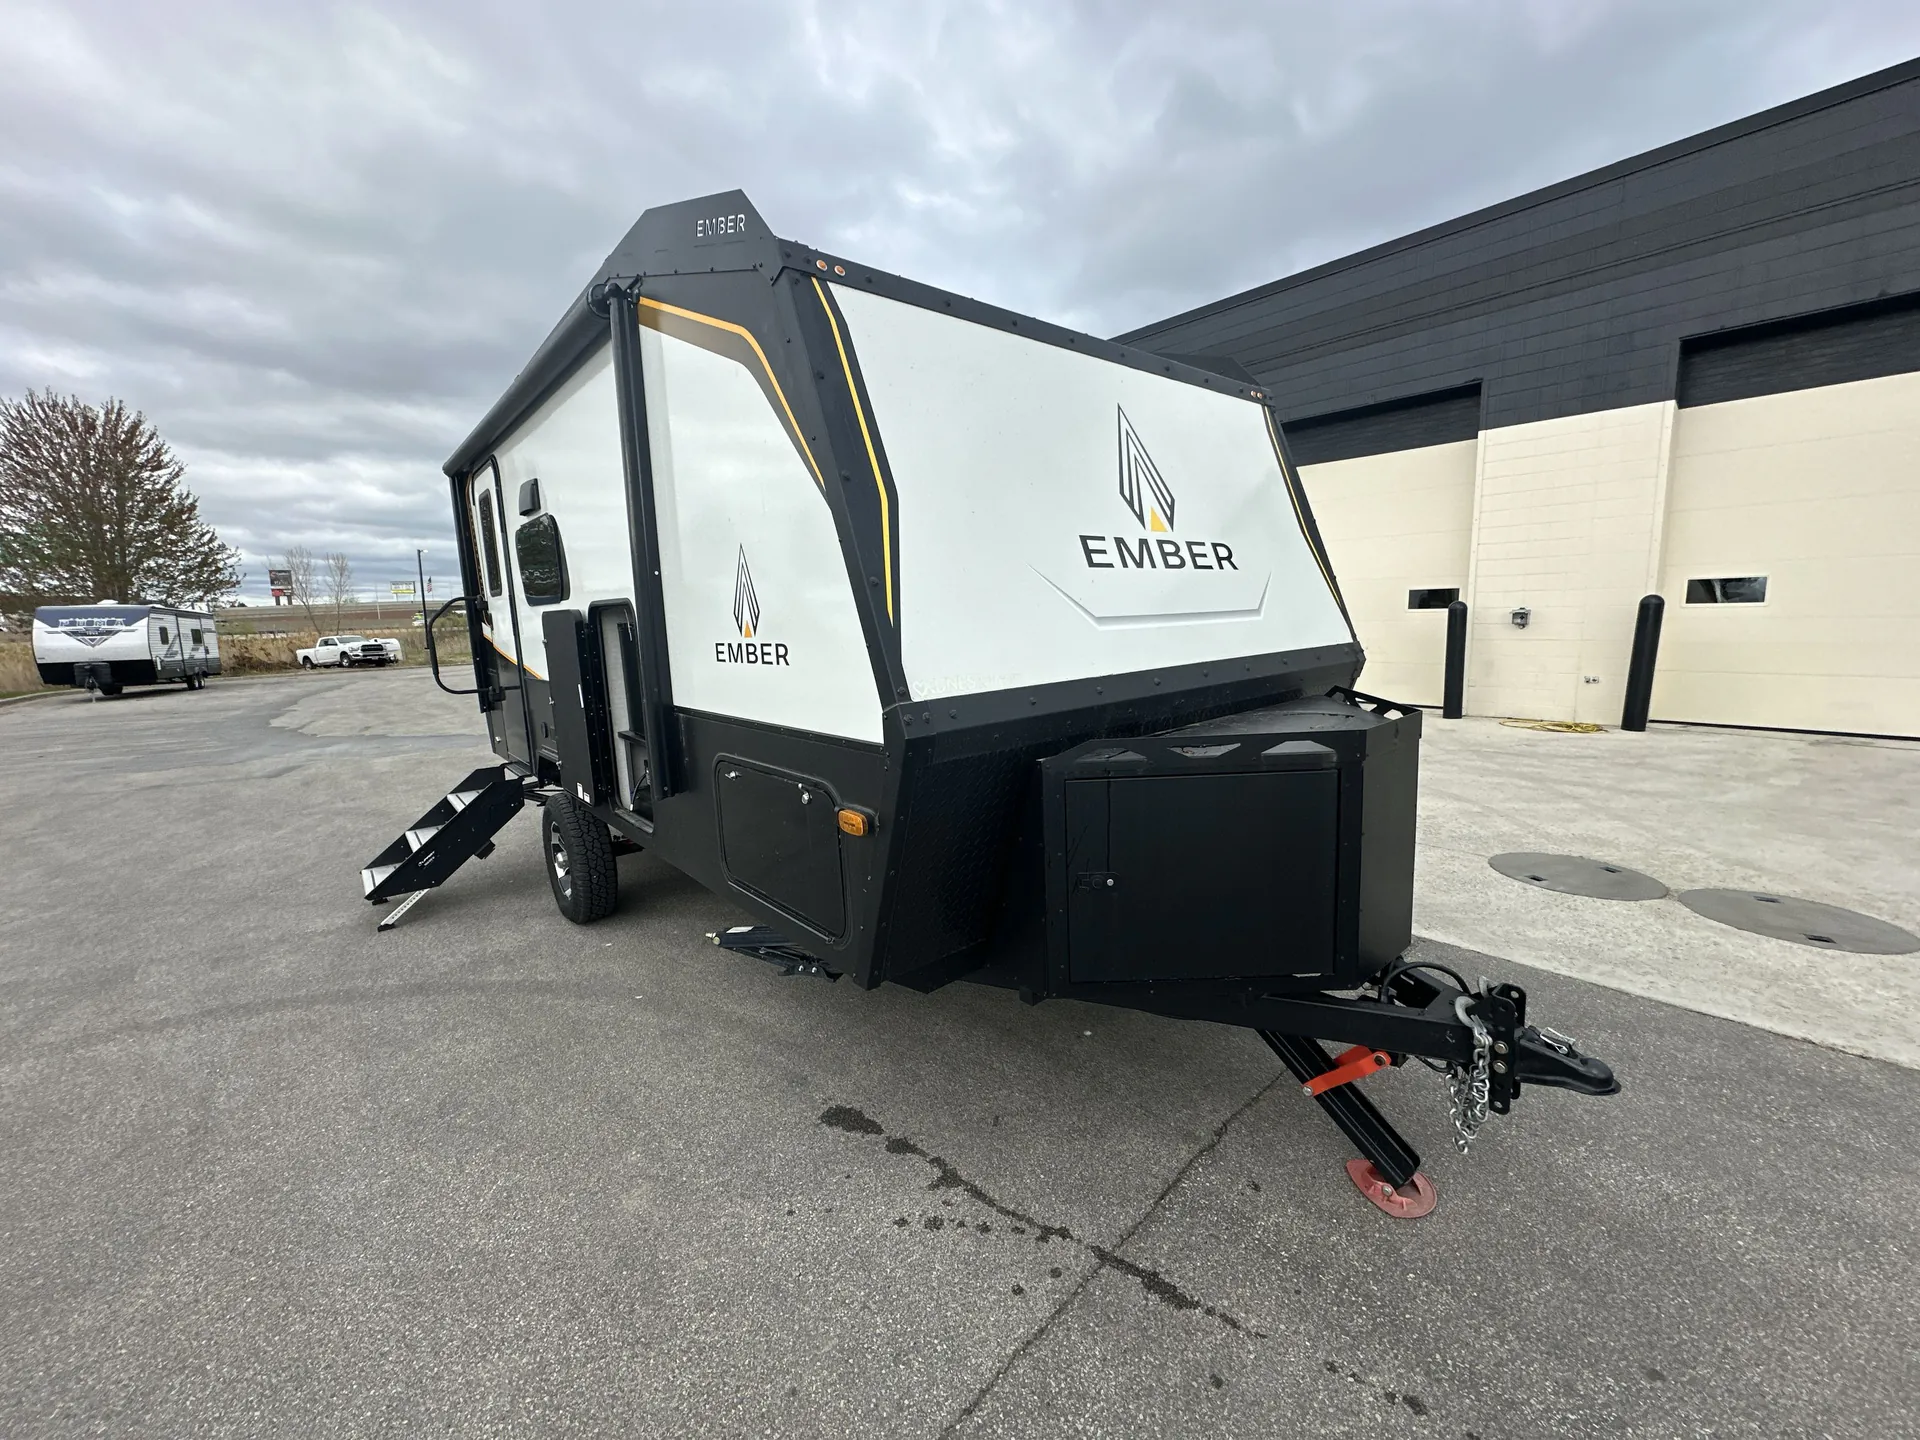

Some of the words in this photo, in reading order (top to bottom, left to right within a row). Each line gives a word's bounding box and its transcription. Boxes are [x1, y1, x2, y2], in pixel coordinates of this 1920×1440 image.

[697, 213, 746, 237] EMBER
[1079, 534, 1239, 571] EMBER
[58, 617, 127, 628] PUMA
[715, 642, 790, 666] EMBER
